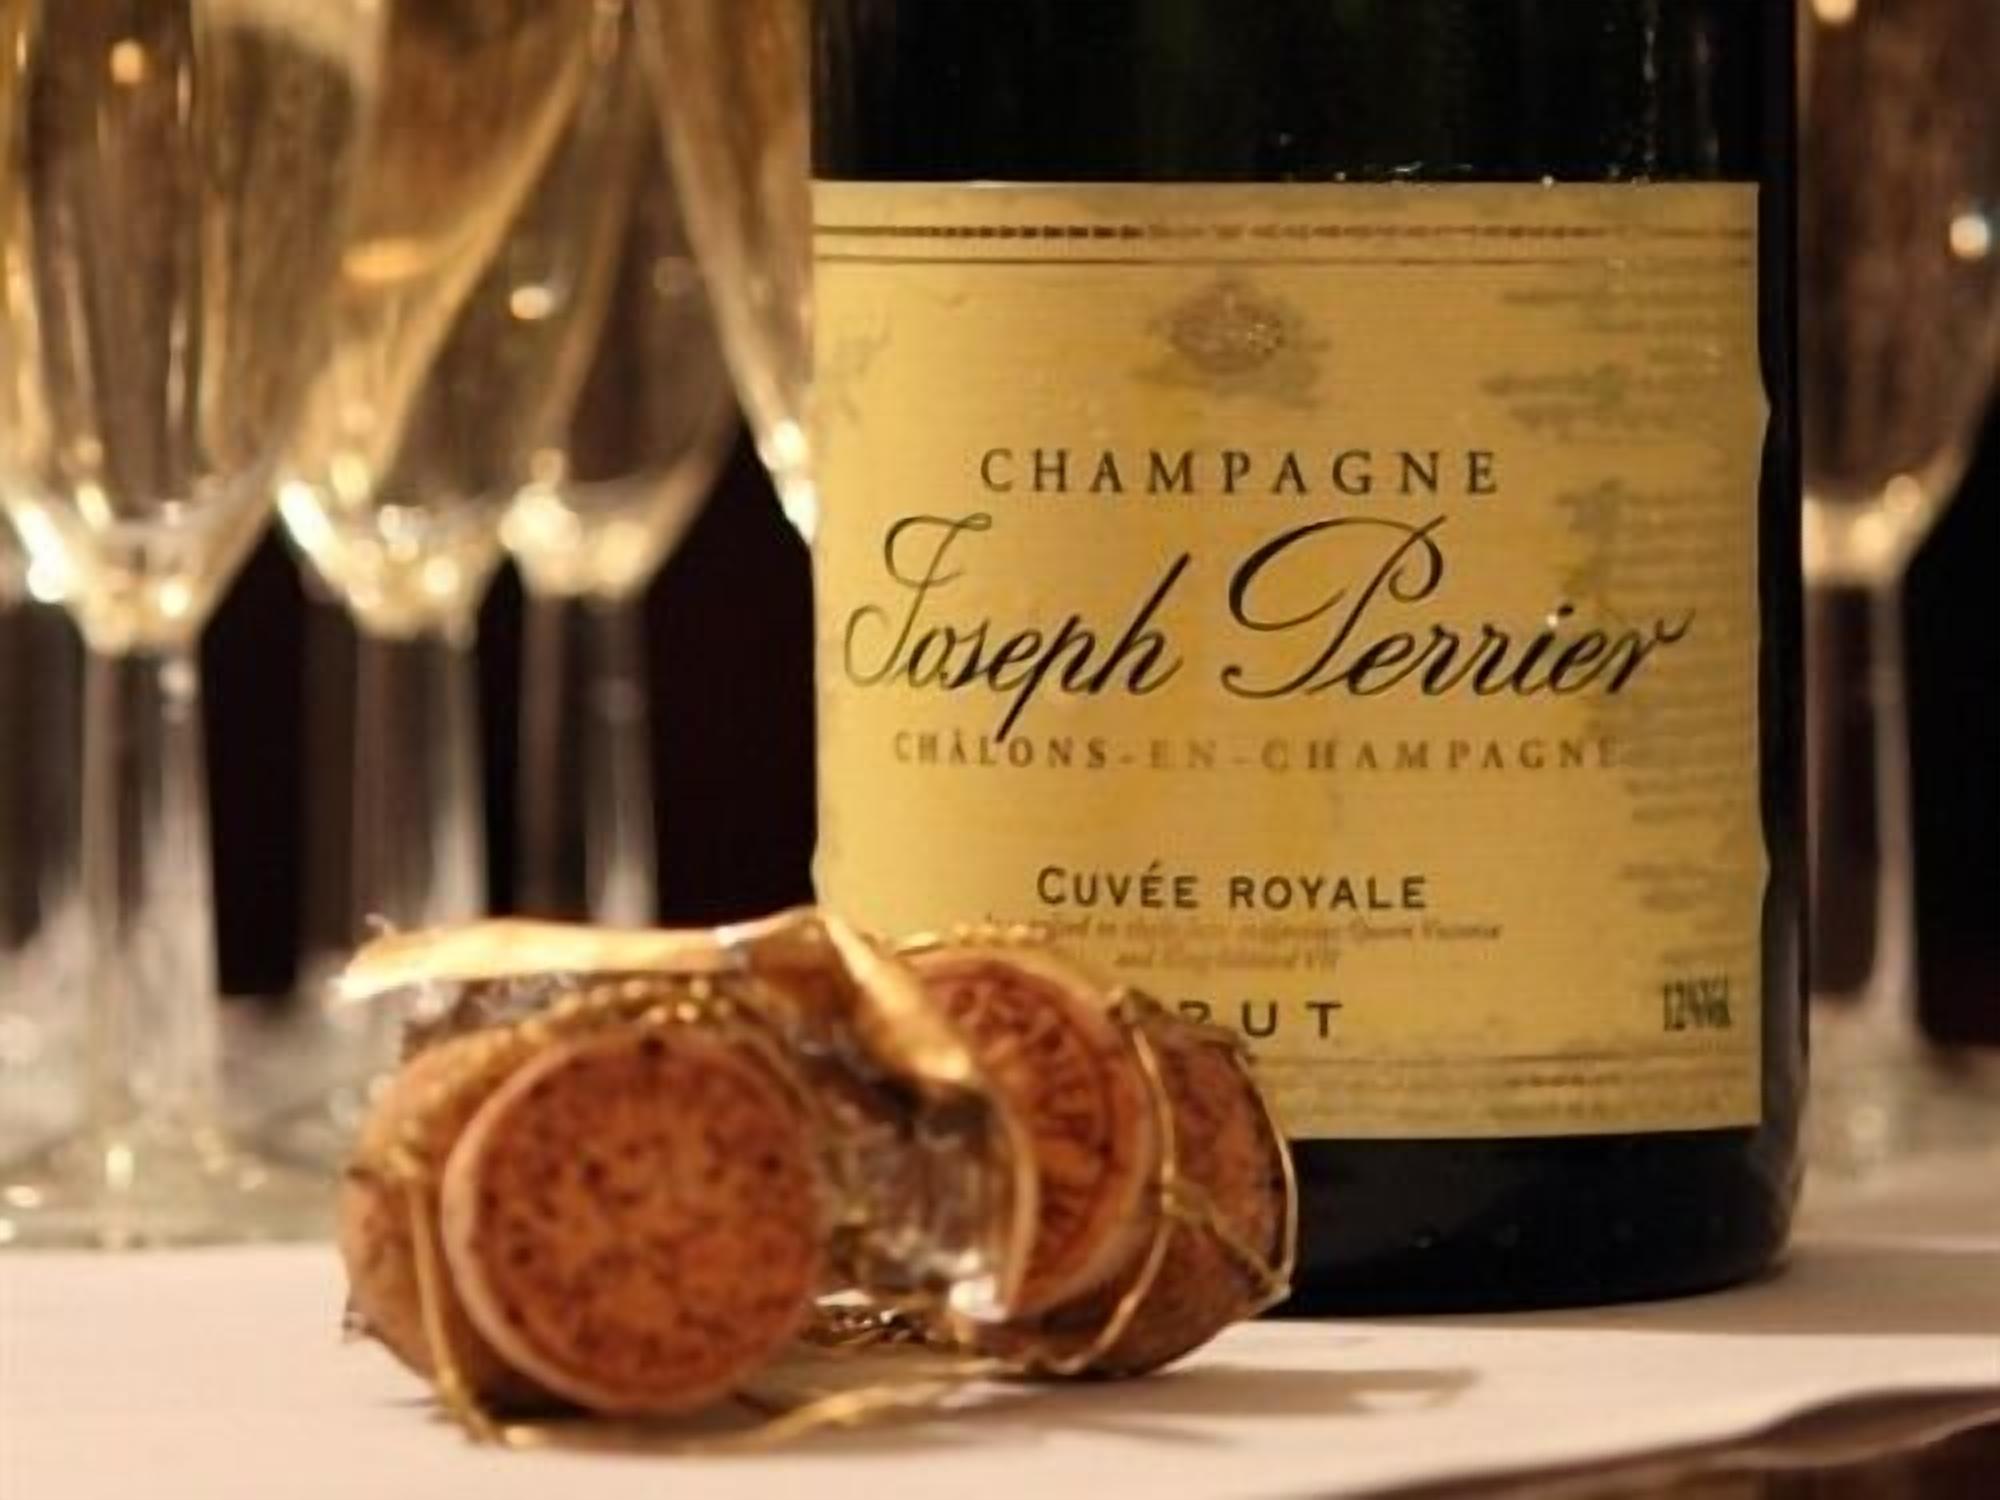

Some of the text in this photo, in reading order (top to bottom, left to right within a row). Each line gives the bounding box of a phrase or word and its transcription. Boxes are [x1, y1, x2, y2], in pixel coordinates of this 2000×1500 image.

[980, 448, 1500, 496] CHAMPAGNE
[844, 512, 1695, 742] Joseph Perrier
[1228, 876, 1428, 911] ROYALE
[1179, 1000, 1343, 1039] RUT
